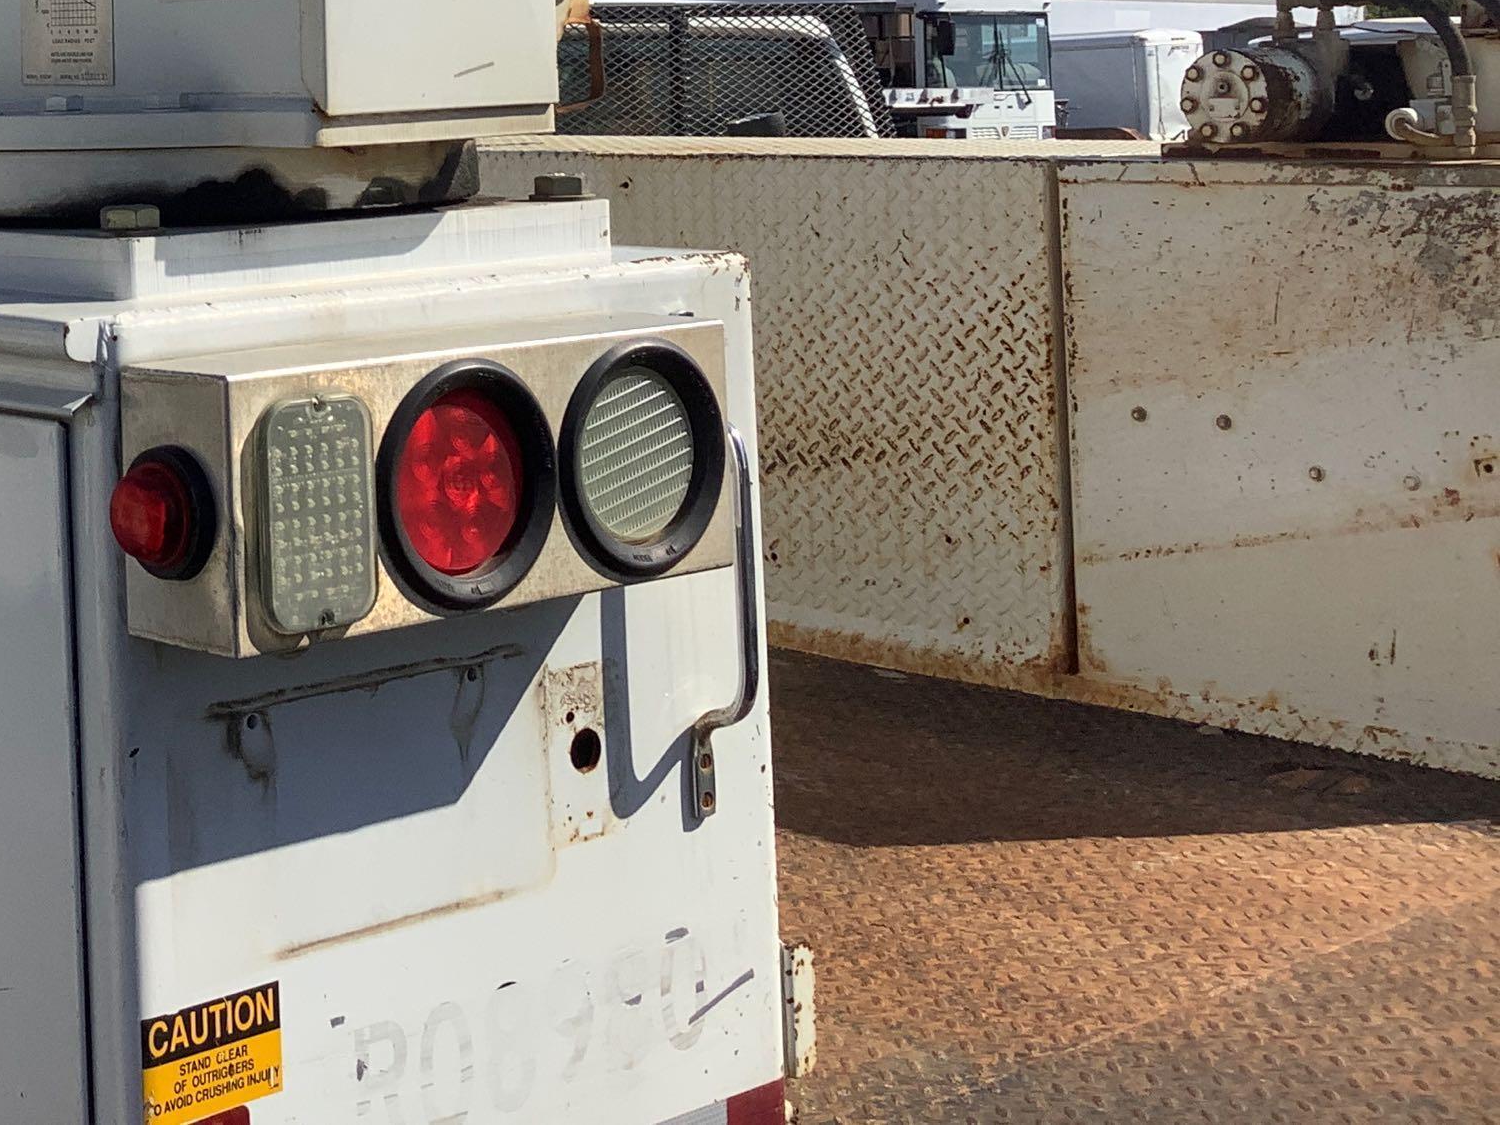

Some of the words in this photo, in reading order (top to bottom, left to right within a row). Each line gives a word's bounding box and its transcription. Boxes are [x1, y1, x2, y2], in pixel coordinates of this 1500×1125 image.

[148, 987, 275, 1059] CAUTION
[174, 1079, 187, 1095] OF
[192, 1058, 255, 1088] OUTRIGGERS
[179, 1056, 211, 1077] STAND
[216, 1044, 248, 1065] CLEAR
[164, 1094, 193, 1115] AVOID
[195, 1077, 245, 1104] CRUSHING
